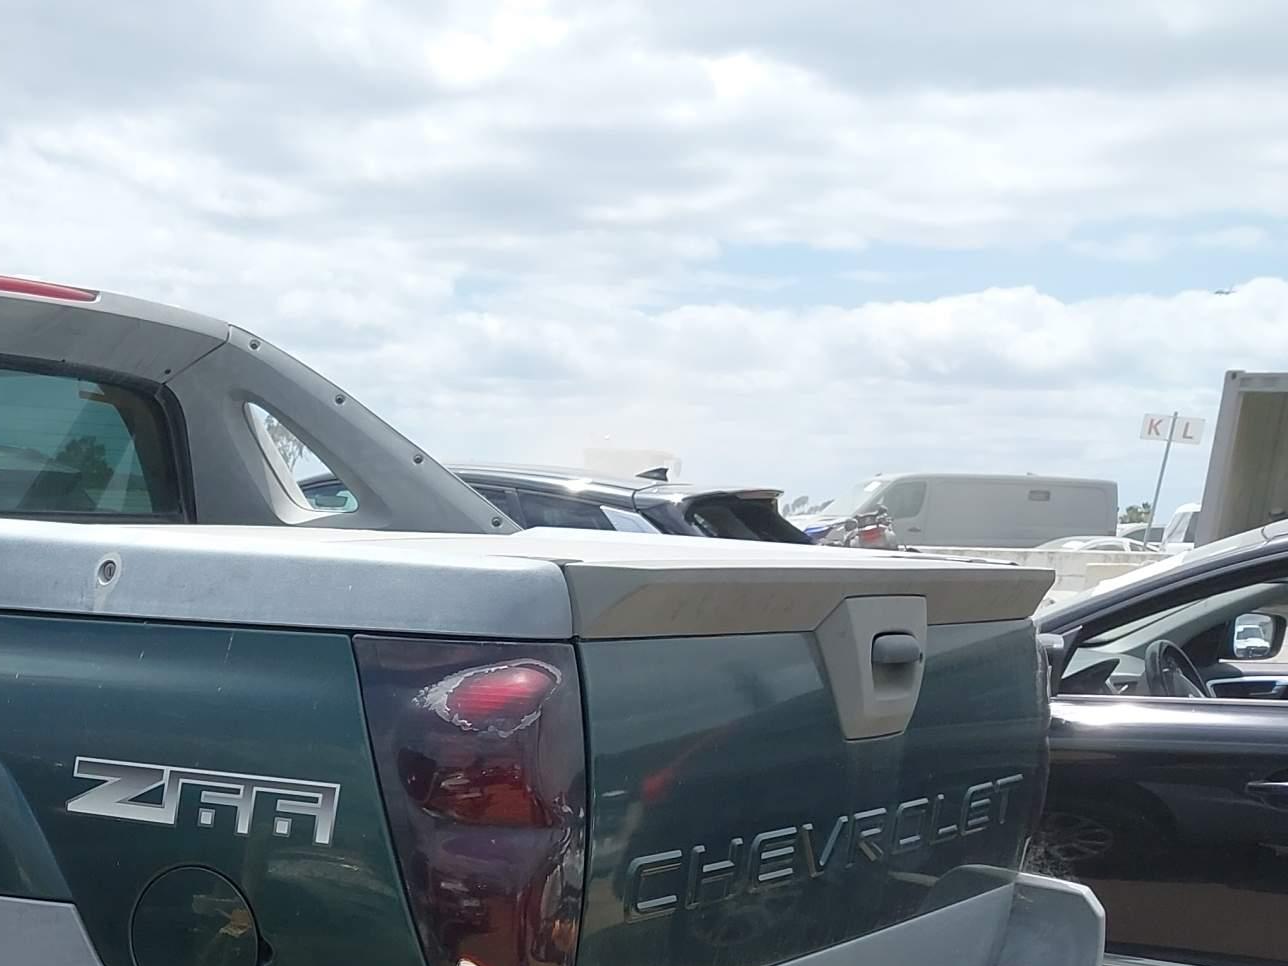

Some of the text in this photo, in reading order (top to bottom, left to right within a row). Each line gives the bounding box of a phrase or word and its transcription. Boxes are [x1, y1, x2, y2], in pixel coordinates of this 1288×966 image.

[1147, 418, 1194, 440] K L
[624, 774, 1024, 924] CHEVROLET
